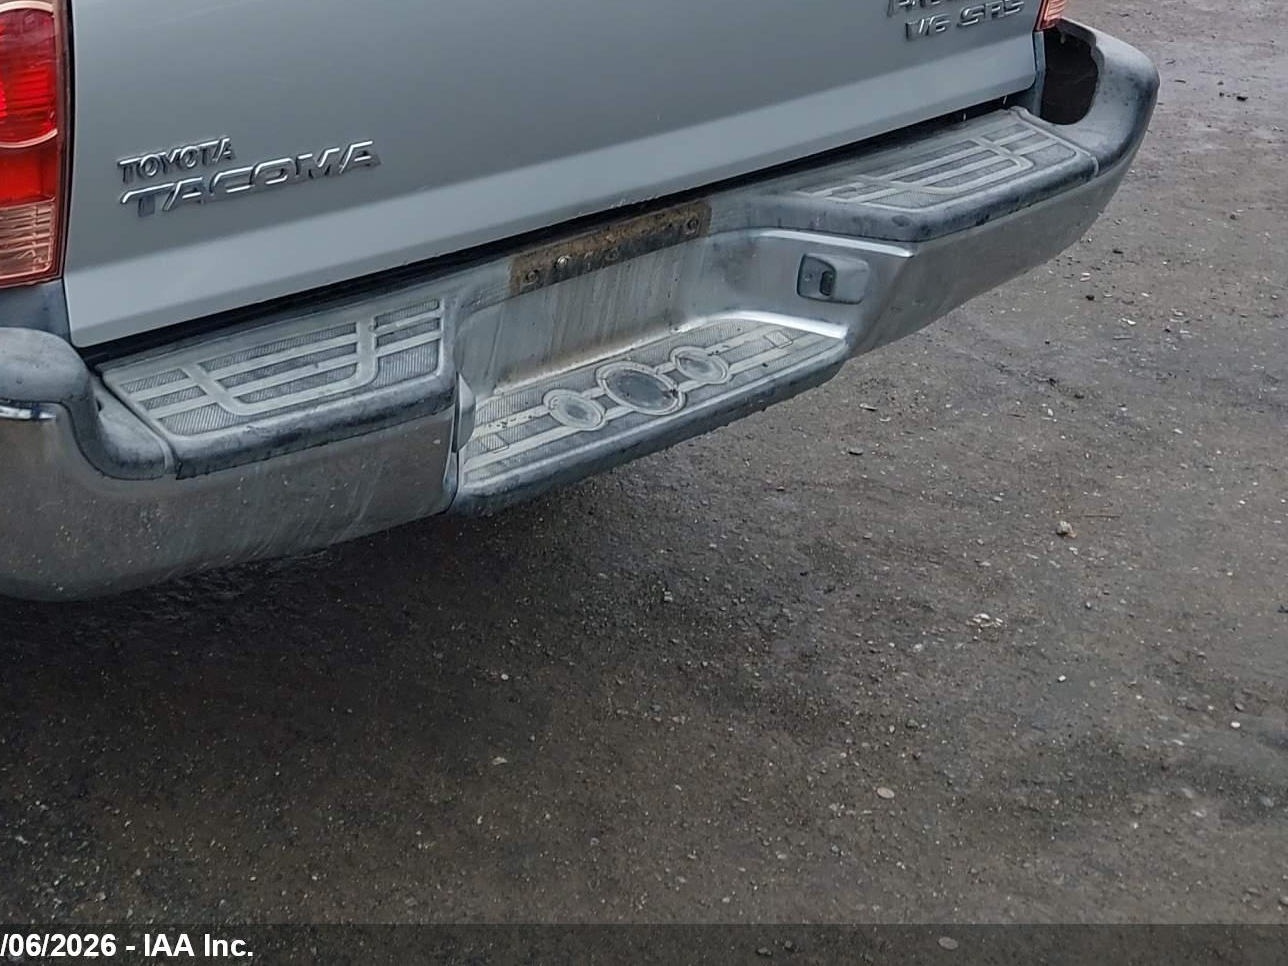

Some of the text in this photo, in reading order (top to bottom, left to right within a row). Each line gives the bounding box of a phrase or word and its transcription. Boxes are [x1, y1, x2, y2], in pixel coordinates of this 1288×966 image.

[905, 12, 952, 42] V6
[118, 135, 235, 184] TOYOTA
[119, 140, 381, 218] TACOMA
